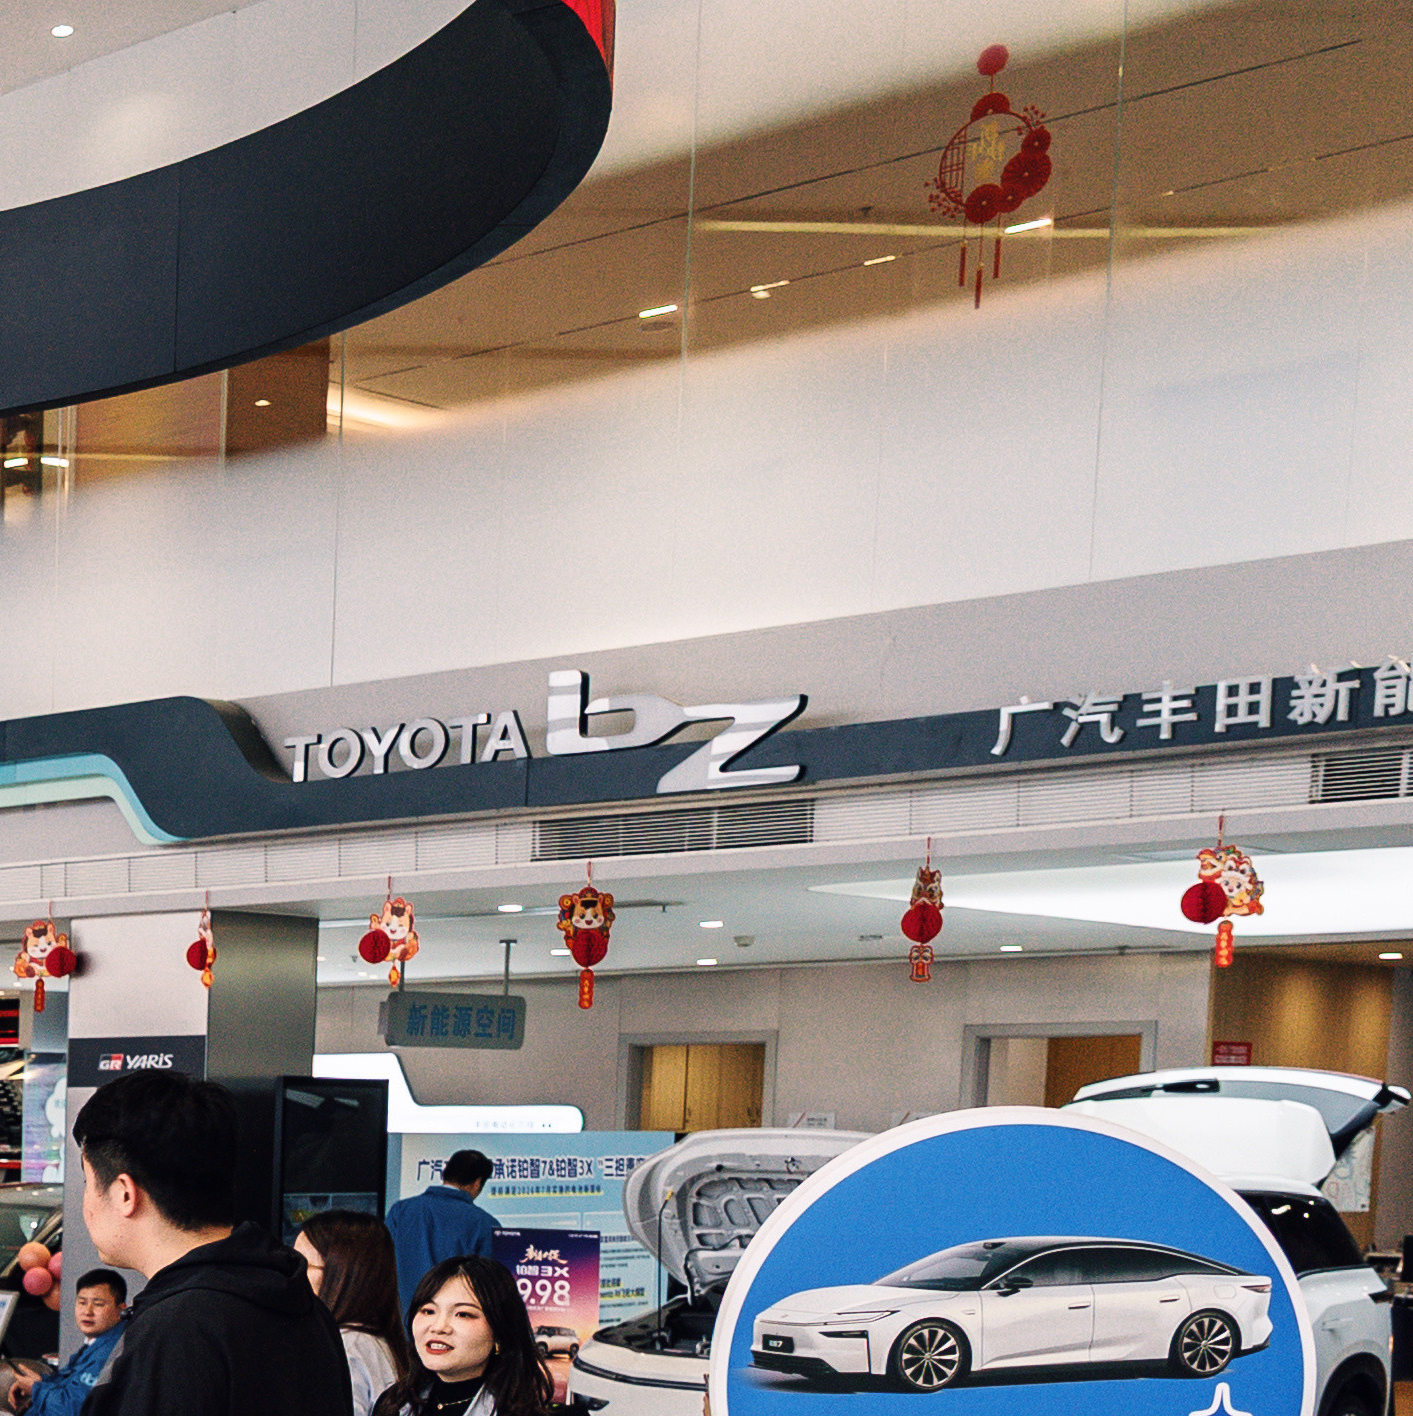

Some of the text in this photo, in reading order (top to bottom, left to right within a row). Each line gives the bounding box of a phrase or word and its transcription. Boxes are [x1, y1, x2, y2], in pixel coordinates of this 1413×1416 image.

[285, 709, 532, 783] TOYOTA
[407, 1004, 516, 1040] 新能源空间
[99, 1054, 124, 1071] GR
